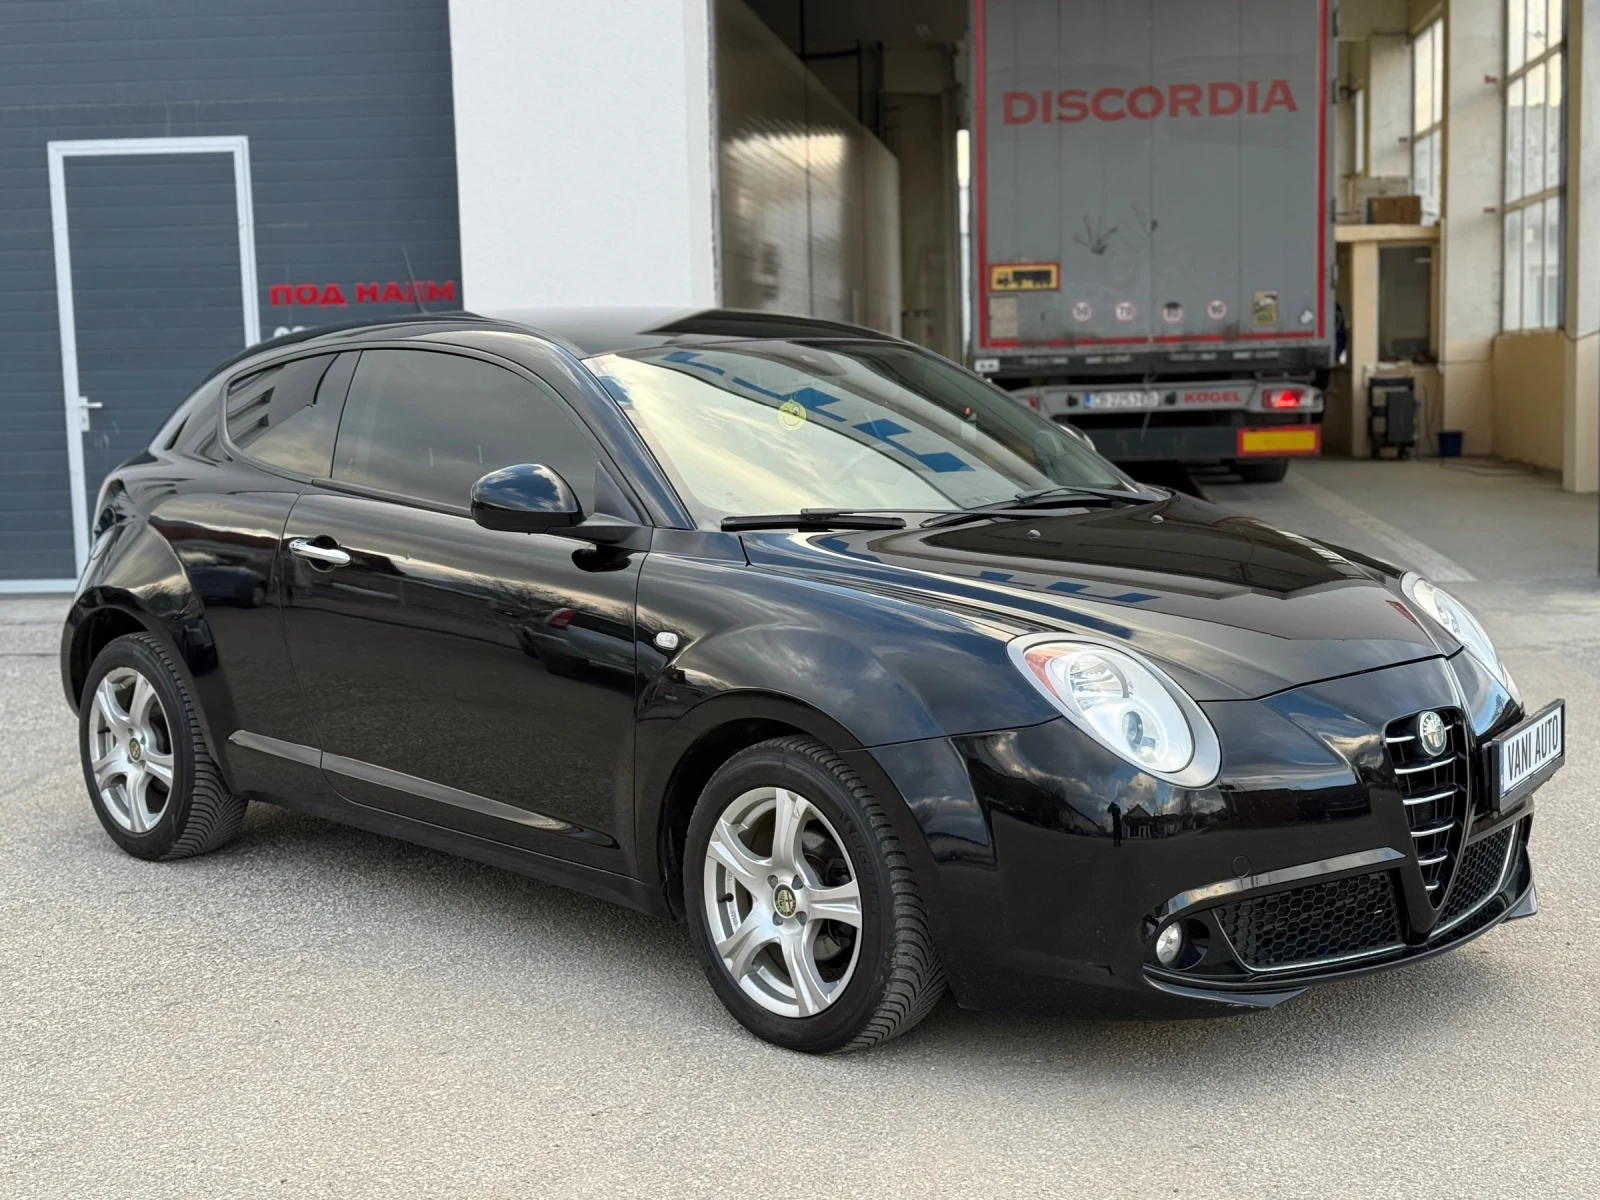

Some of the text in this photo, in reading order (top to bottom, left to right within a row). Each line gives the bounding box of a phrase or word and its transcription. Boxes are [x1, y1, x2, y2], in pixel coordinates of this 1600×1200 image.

[1002, 79, 1299, 126] DISCORDIA
[269, 280, 456, 308] ПОД НАЕМ
[1507, 714, 1559, 781] VANI AUTO
